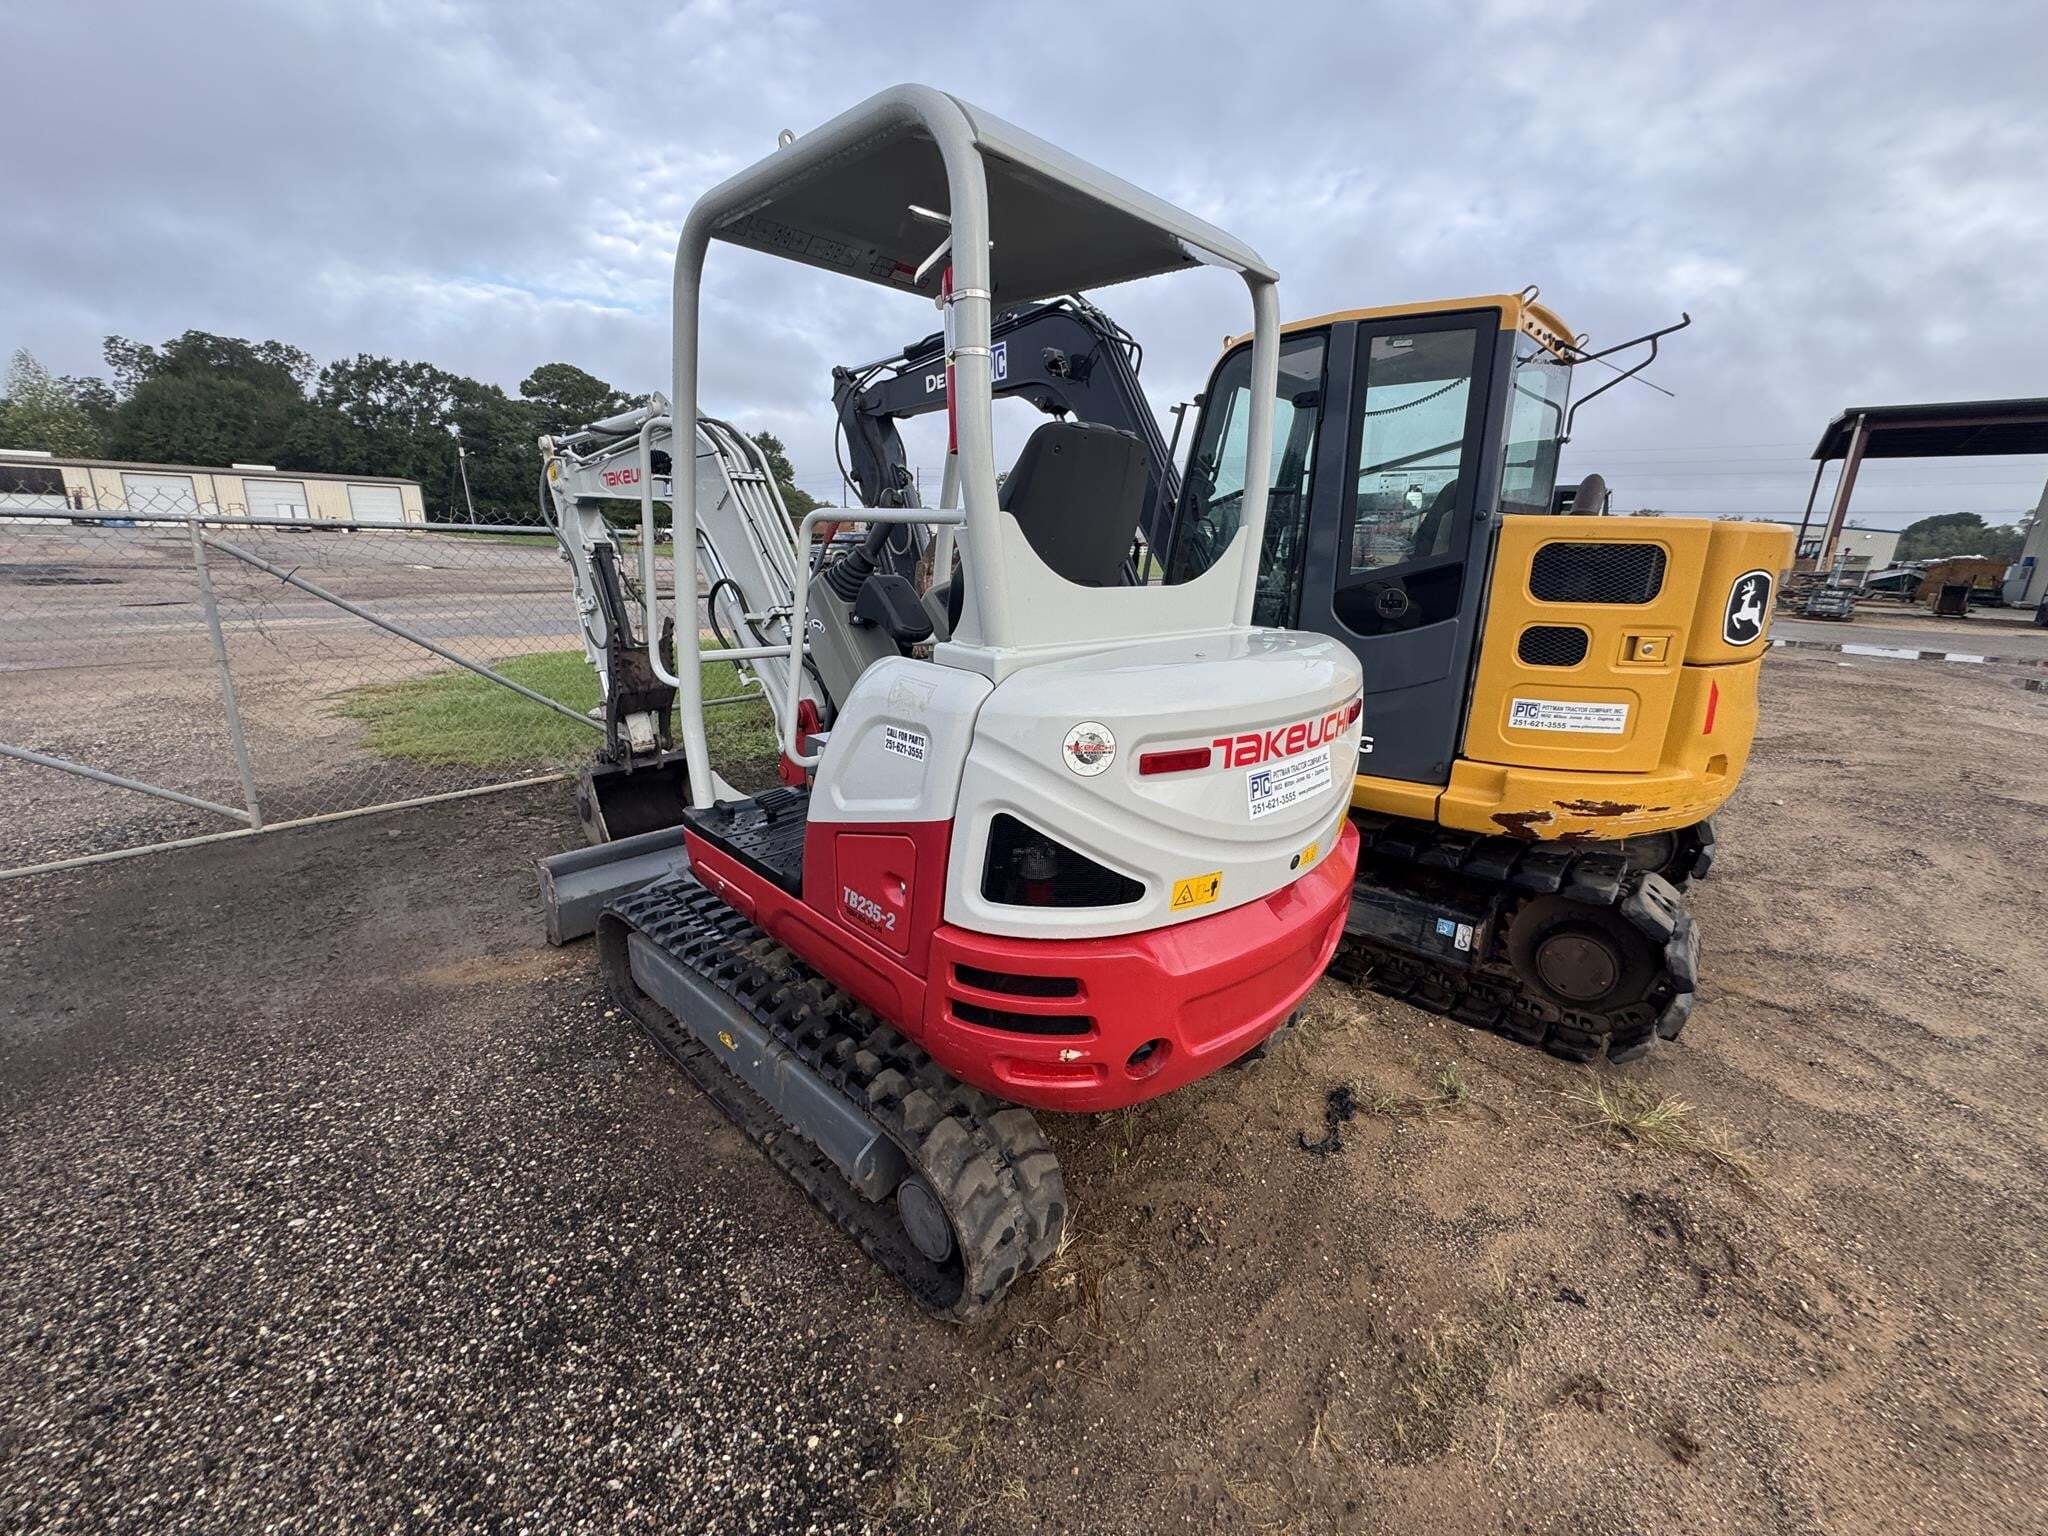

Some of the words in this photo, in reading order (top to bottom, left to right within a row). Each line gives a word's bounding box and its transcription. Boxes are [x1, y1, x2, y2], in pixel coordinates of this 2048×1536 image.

[991, 344, 1005, 379] TC
[1515, 702, 1538, 718] PTC
[1513, 719, 1567, 729] 251-621-3555
[886, 727, 898, 738] CALL
[898, 731, 908, 741] FOR
[908, 734, 924, 747] PARTS
[886, 738, 923, 760] 251-621-3555
[1251, 772, 1271, 799] PTC
[1252, 791, 1296, 815] 251-621-3555
[843, 886, 896, 931] TB235-2
